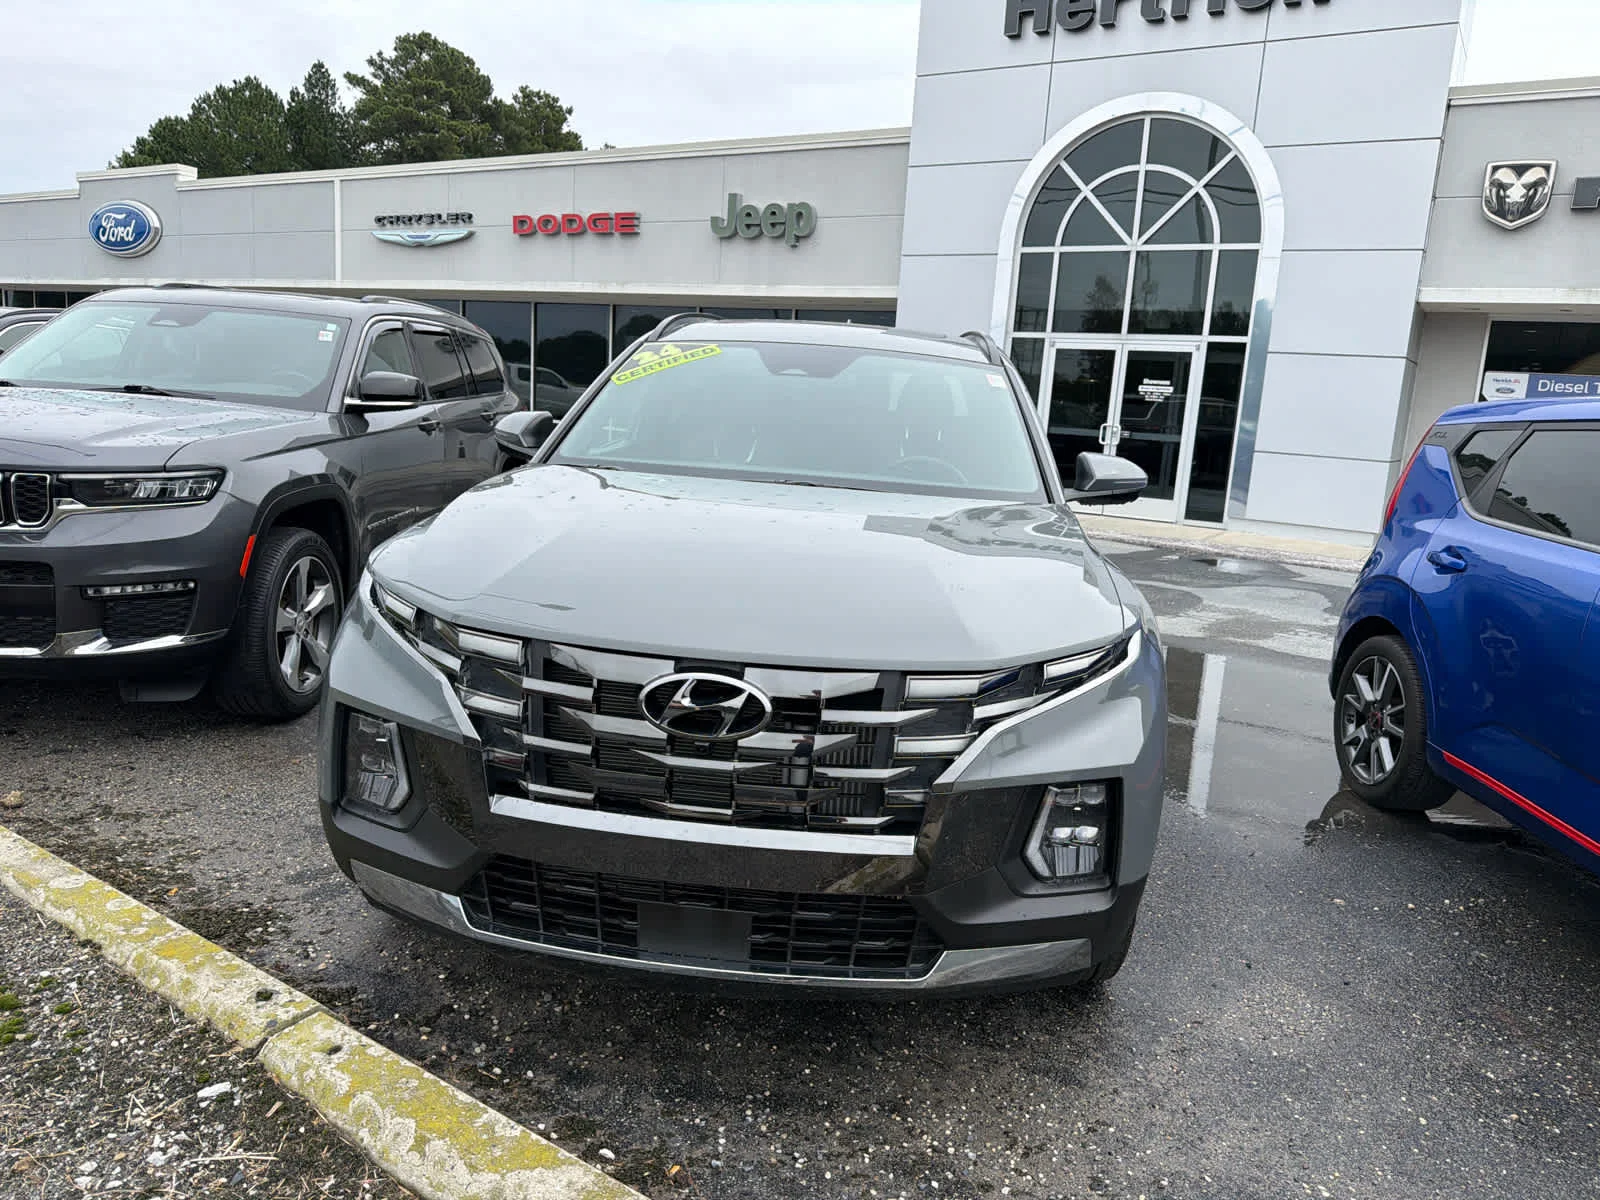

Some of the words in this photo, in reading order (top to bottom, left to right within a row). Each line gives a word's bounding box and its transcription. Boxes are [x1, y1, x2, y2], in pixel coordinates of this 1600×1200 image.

[98, 212, 137, 242] Ford
[374, 212, 473, 226] CHRYSLER
[512, 212, 640, 236] DODGE
[710, 193, 816, 248] Jeep
[614, 346, 718, 382] CERTIFIED
[1537, 379, 1589, 394] Diesel
